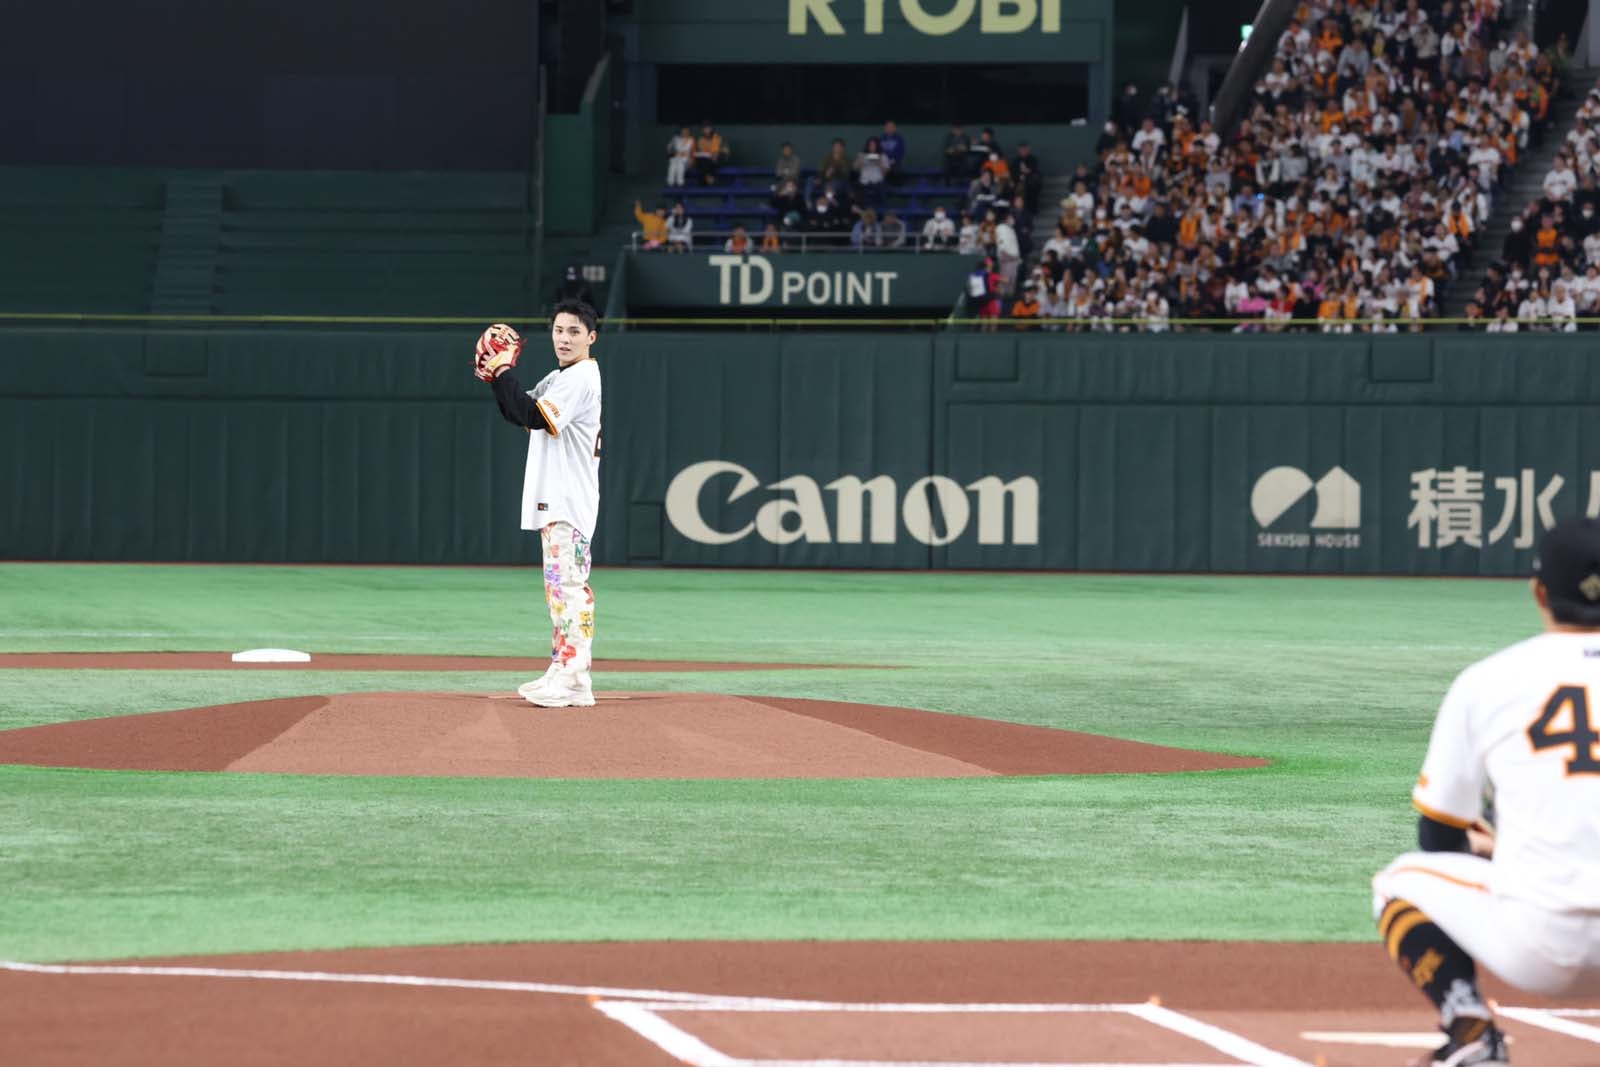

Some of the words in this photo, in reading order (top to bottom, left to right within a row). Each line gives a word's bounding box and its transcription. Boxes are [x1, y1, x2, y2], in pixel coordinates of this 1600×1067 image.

[708, 254, 774, 305] TD
[781, 271, 898, 306] POINT
[665, 460, 1040, 546] Canon
[1407, 465, 1600, 549] 積水
[1315, 533, 1360, 548] HOUSE
